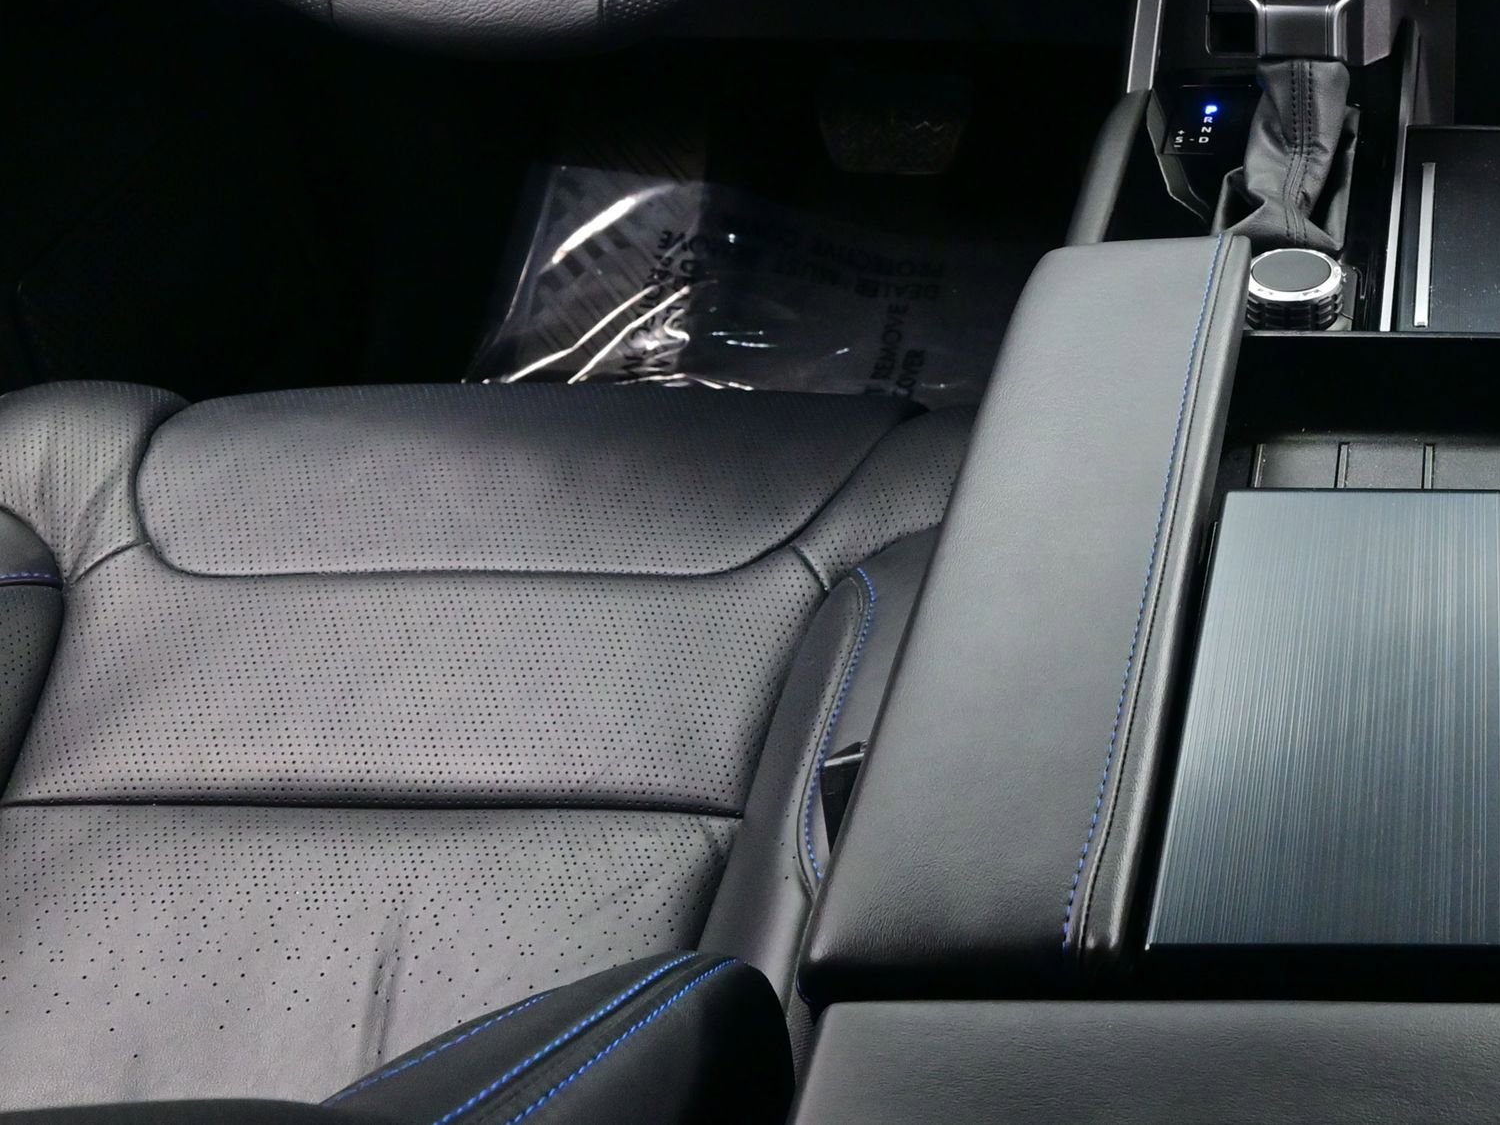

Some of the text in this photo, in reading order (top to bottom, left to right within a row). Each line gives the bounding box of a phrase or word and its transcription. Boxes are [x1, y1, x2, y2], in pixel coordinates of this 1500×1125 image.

[1204, 104, 1218, 115] P
[1203, 115, 1214, 124] R
[1200, 126, 1213, 134] N
[1174, 135, 1184, 144] S
[1198, 135, 1210, 144] D
